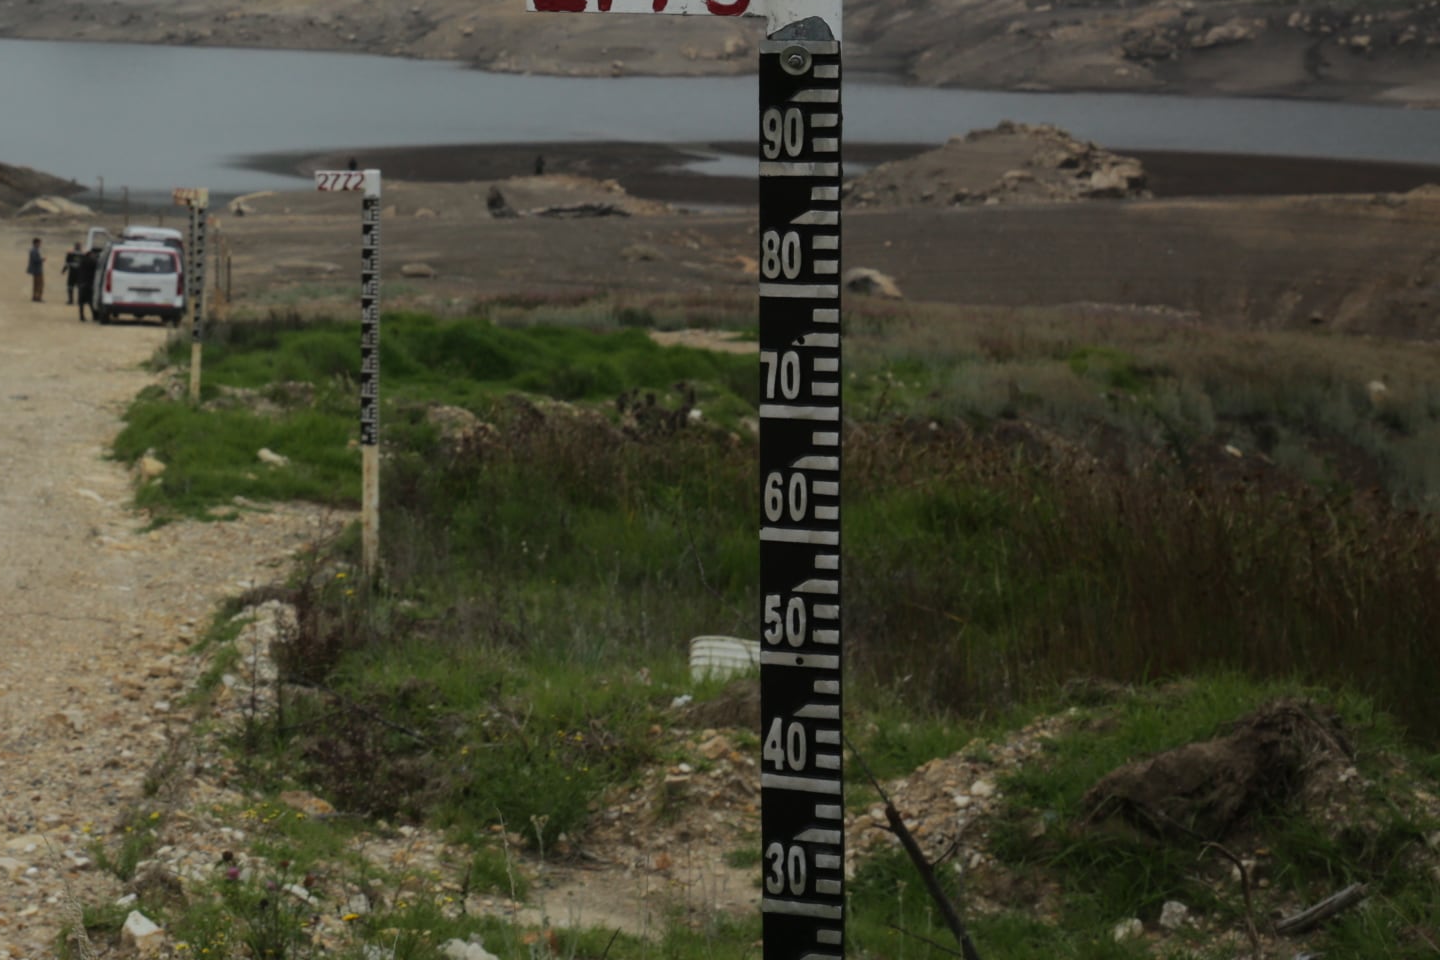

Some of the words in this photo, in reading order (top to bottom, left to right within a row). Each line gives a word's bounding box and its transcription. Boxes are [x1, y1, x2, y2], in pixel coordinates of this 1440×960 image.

[762, 107, 804, 159] 90
[317, 172, 365, 191] 2772
[761, 230, 802, 280] 80
[760, 350, 801, 400] 70
[764, 471, 808, 522] 60
[764, 594, 807, 647] 50
[763, 717, 807, 771] 40
[765, 841, 807, 895] 30
